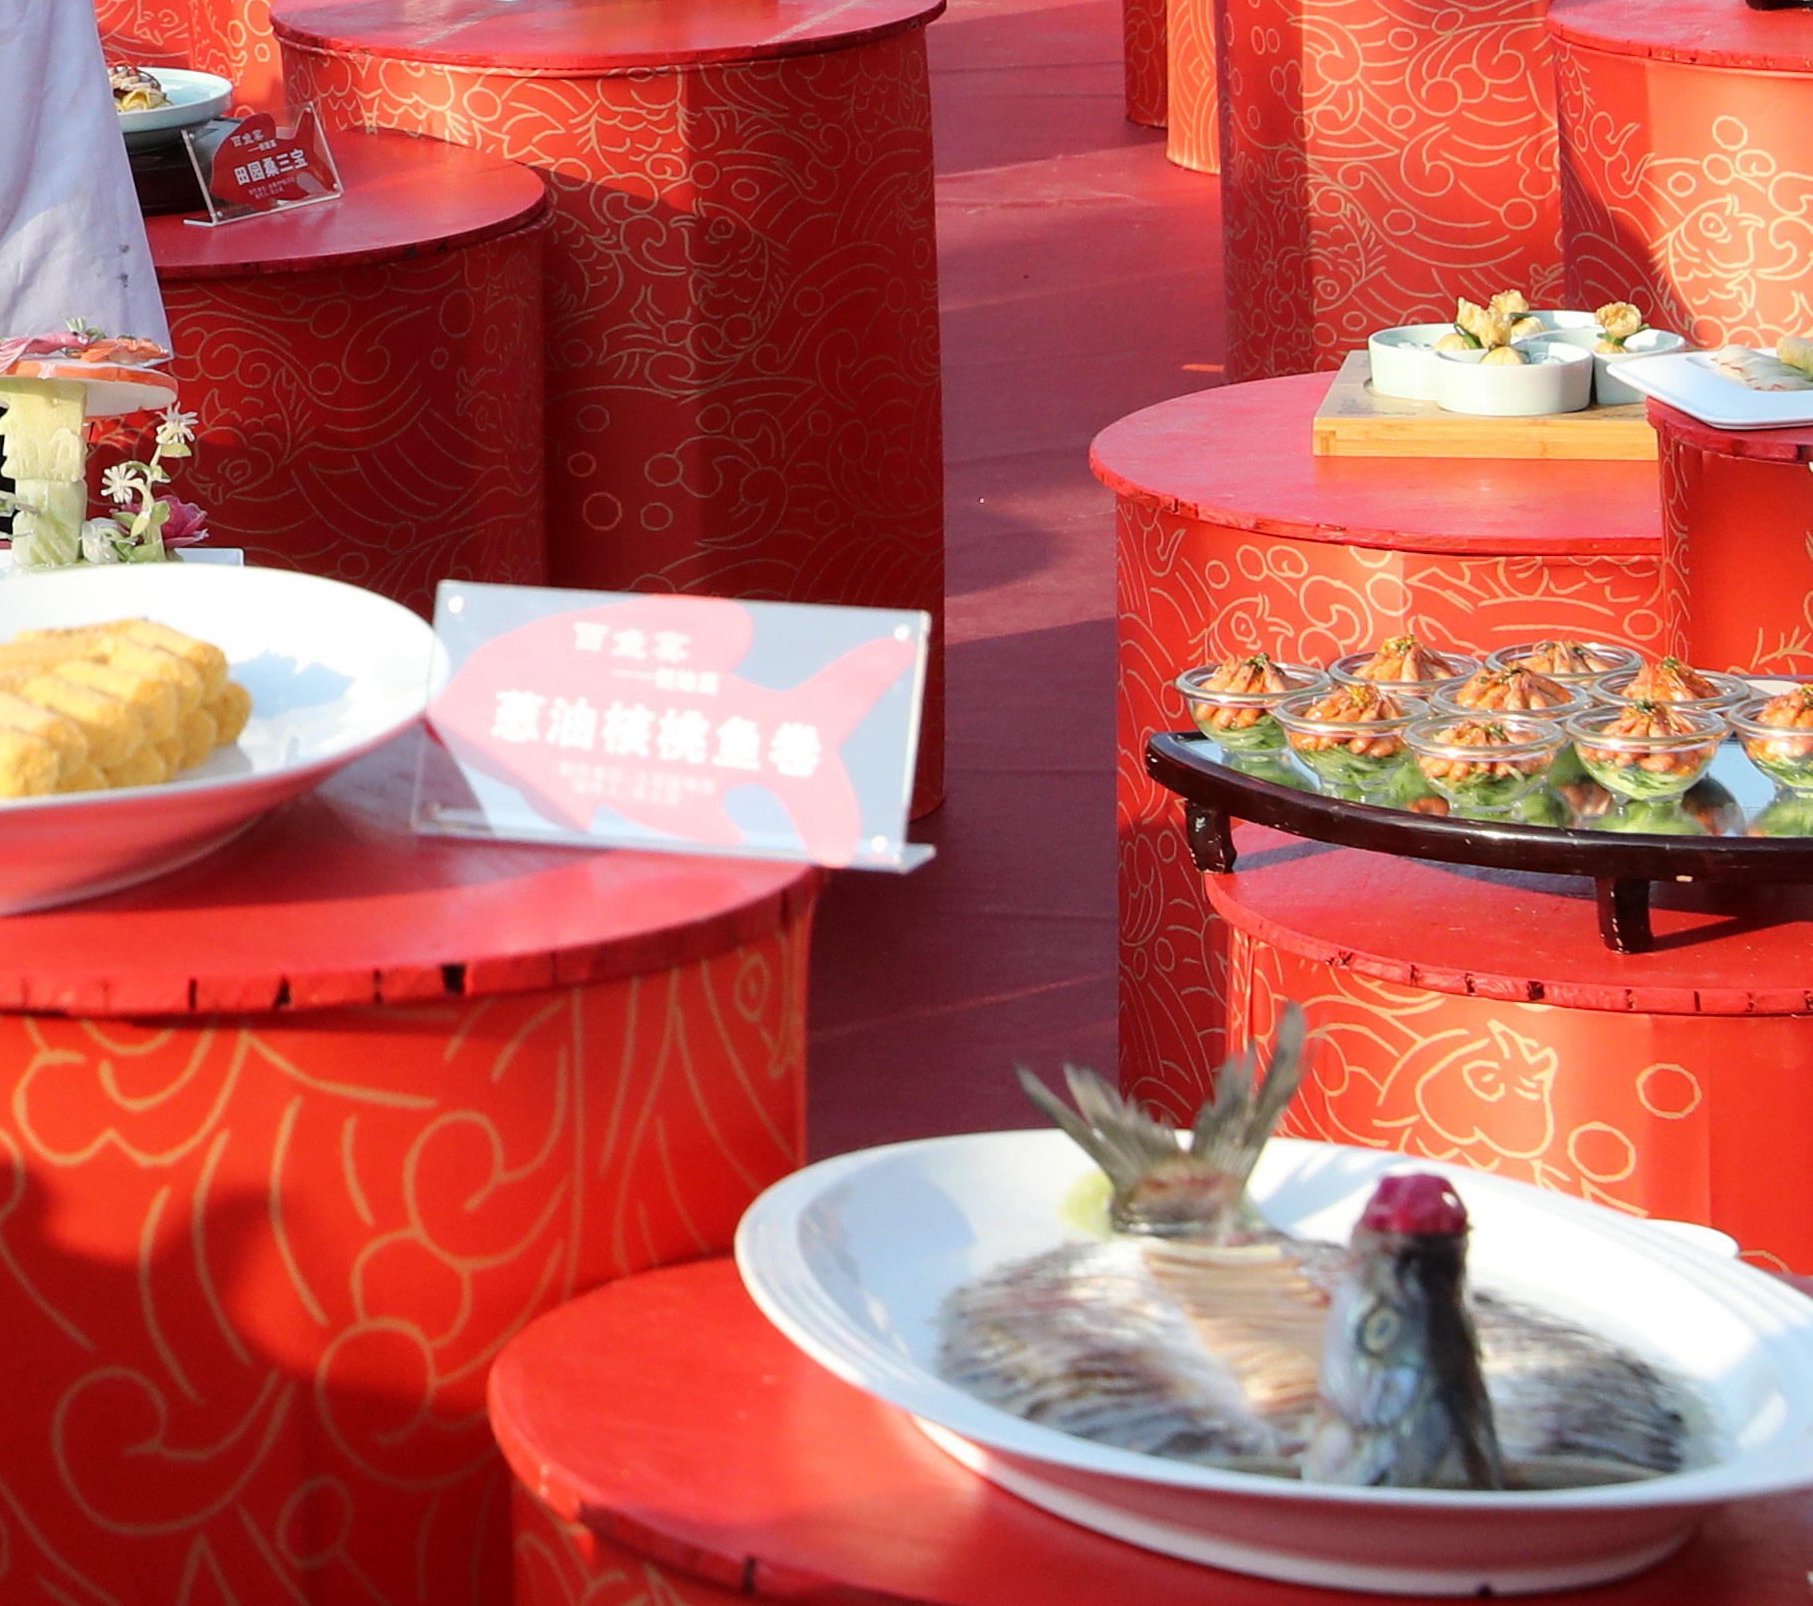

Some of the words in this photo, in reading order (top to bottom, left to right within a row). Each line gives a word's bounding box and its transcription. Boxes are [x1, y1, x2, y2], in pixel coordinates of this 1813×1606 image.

[234, 148, 308, 186] 田园桑三宝
[572, 620, 692, 662] 百鱼宴
[489, 688, 823, 779] 葱油核桃鱼卷
